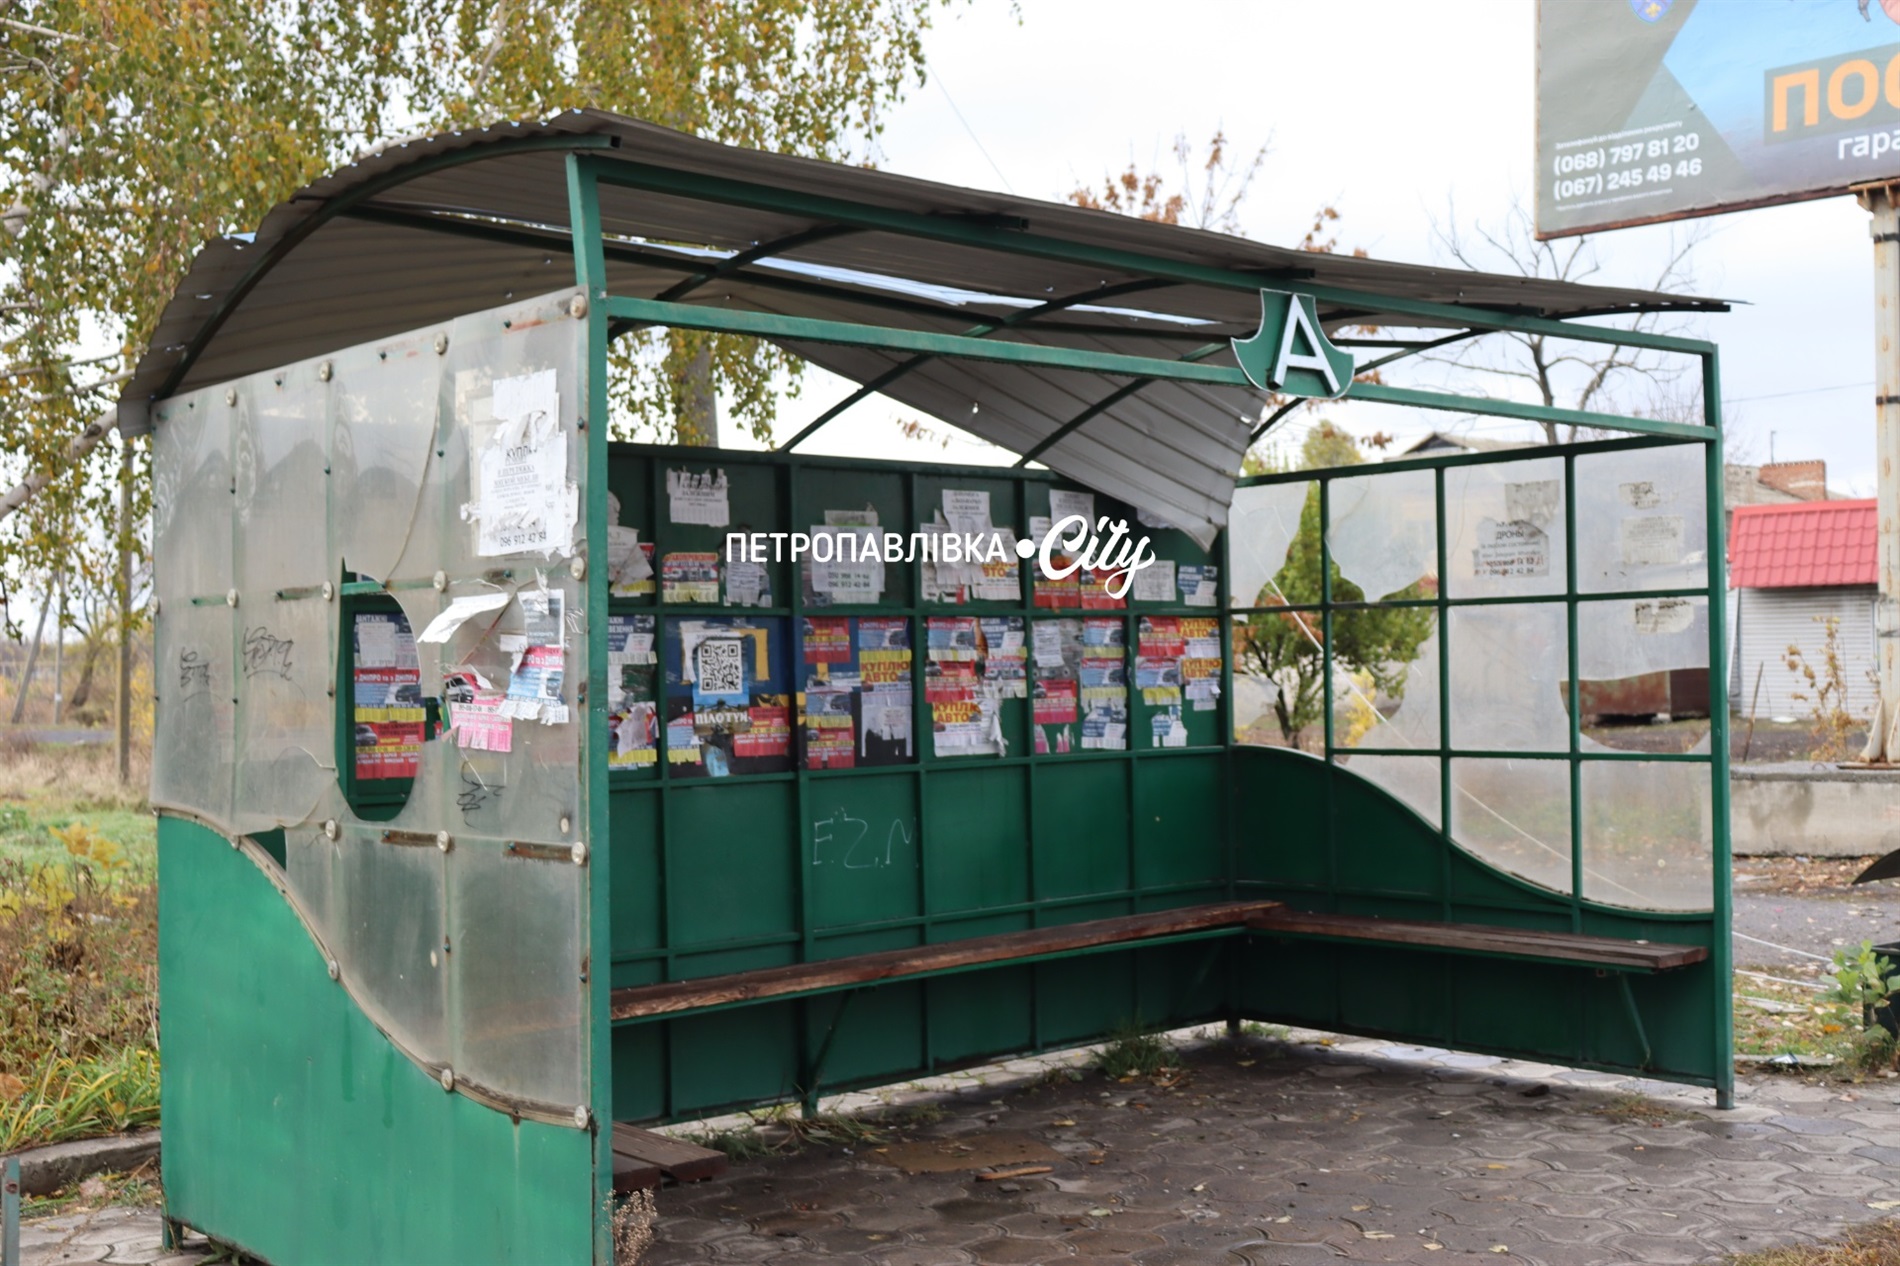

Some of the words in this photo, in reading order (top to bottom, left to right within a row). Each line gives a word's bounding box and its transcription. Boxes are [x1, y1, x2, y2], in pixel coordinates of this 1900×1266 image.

[1553, 147, 1605, 176] (068)
[1609, 142, 1644, 164] 797
[1647, 137, 1669, 158] 81
[1673, 132, 1699, 153] 20
[1553, 173, 1603, 200] (067)
[1606, 167, 1643, 191] 245
[1646, 162, 1672, 183] 49
[1675, 157, 1702, 177] 46
[1273, 292, 1341, 394] А
